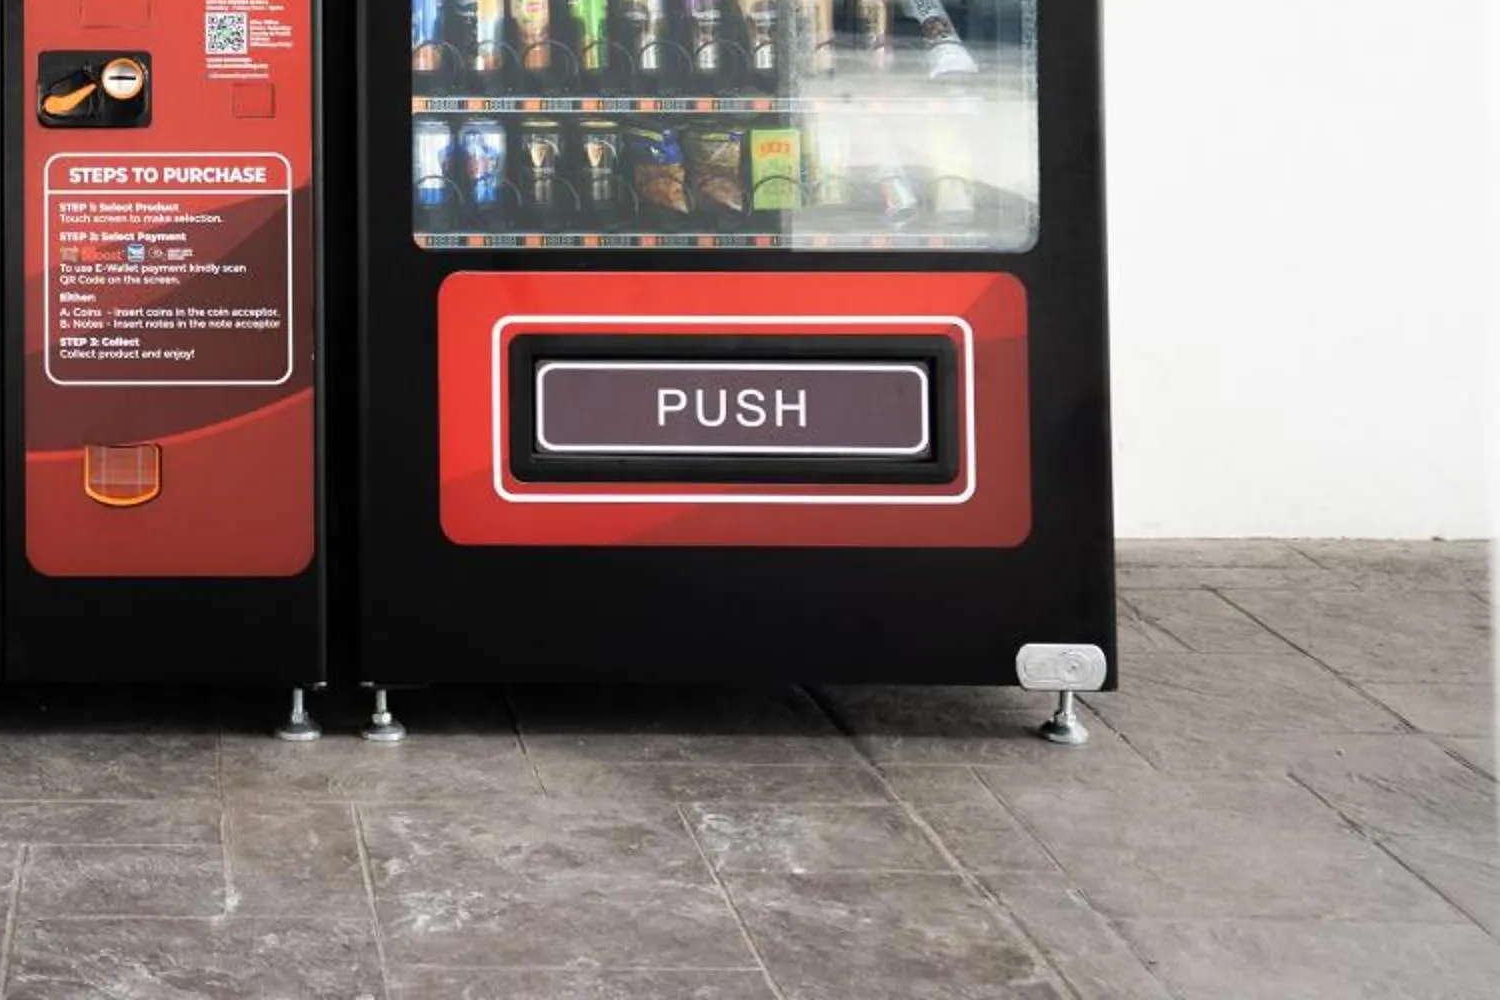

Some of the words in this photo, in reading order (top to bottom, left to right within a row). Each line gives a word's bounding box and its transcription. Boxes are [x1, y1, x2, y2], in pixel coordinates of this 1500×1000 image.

[68, 167, 128, 184] STEPS
[132, 167, 159, 184] TO
[163, 167, 267, 184] PURCHASE
[59, 202, 87, 213] STEP
[100, 202, 134, 213] Select
[136, 202, 180, 213] Product
[60, 213, 91, 223] Touch
[93, 215, 128, 223] screen
[130, 214, 142, 223] to
[144, 213, 172, 223] make
[59, 231, 87, 242] STEP
[102, 231, 136, 242] Select
[138, 231, 188, 243] Payment
[60, 263, 73, 273] To
[75, 265, 94, 273] use
[96, 263, 139, 273] E-Wallet
[141, 263, 188, 275] payment
[190, 263, 221, 275] kindly
[223, 265, 247, 273] scan
[60, 275, 77, 285] QR
[78, 275, 106, 285] Code
[108, 277, 122, 285] on
[124, 275, 142, 285] the
[73, 307, 103, 317] Coins
[146, 307, 174, 317] coins
[176, 307, 186, 317] in
[188, 307, 205, 317] the
[207, 307, 230, 317] coin
[73, 319, 104, 329] Notes
[113, 319, 144, 329] Insert
[146, 319, 175, 329] notes
[177, 319, 187, 329] in
[189, 319, 206, 329] the
[208, 319, 233, 329] note
[60, 337, 88, 347] STEP
[102, 337, 141, 347] Collect
[60, 349, 97, 360] Collect
[98, 349, 140, 361] product
[142, 349, 162, 359] and
[164, 349, 196, 361] enjoy!
[657, 388, 808, 428] PUSH
